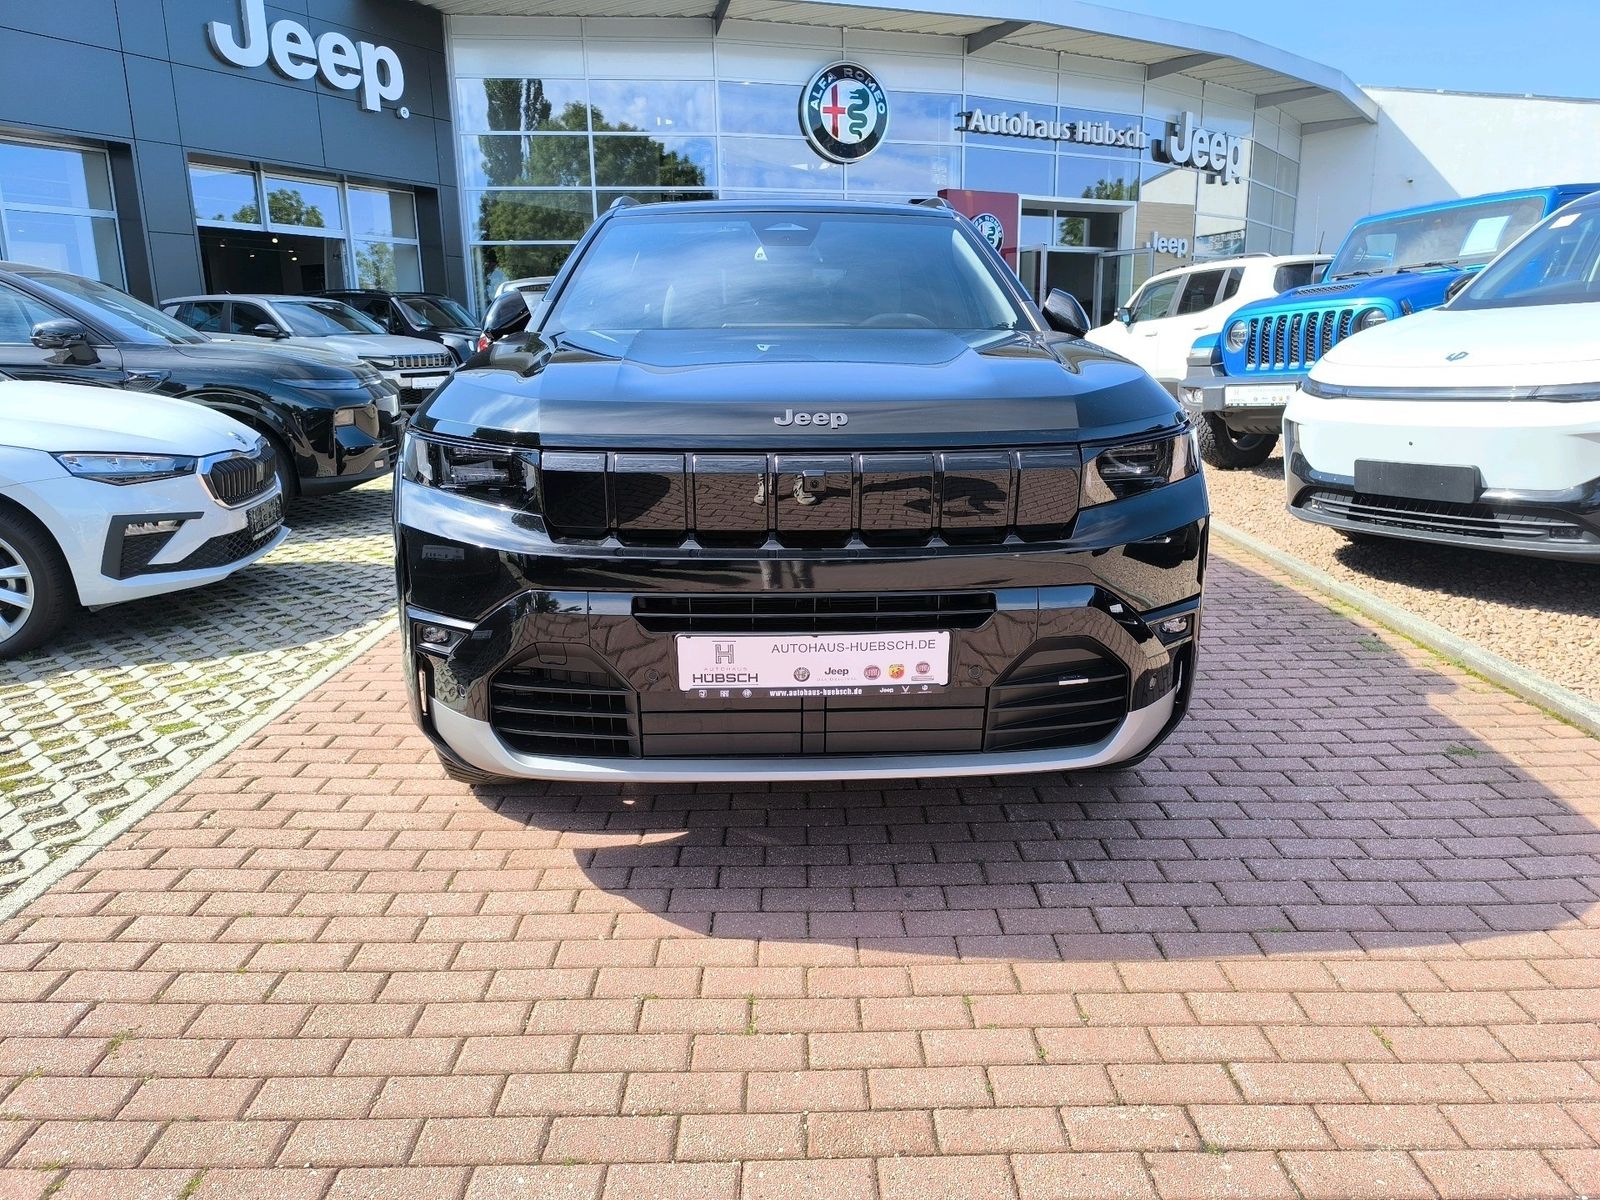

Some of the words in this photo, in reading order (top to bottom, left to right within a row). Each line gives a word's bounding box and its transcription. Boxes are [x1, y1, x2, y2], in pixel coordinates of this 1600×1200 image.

[207, 0, 405, 112] Jeep
[810, 71, 837, 110] ALFA
[843, 67, 886, 114] ROMEO
[968, 108, 1070, 141] Autohaus
[1076, 119, 1146, 149] Hübsch
[1169, 111, 1242, 183] Jeep
[1146, 231, 1188, 258] Jeep
[773, 408, 849, 429] Jeep
[771, 639, 936, 654] AUTOHAUS-HUEBSCH.DE
[692, 672, 759, 683] HÜBSCH
[824, 667, 850, 677] Jeep
